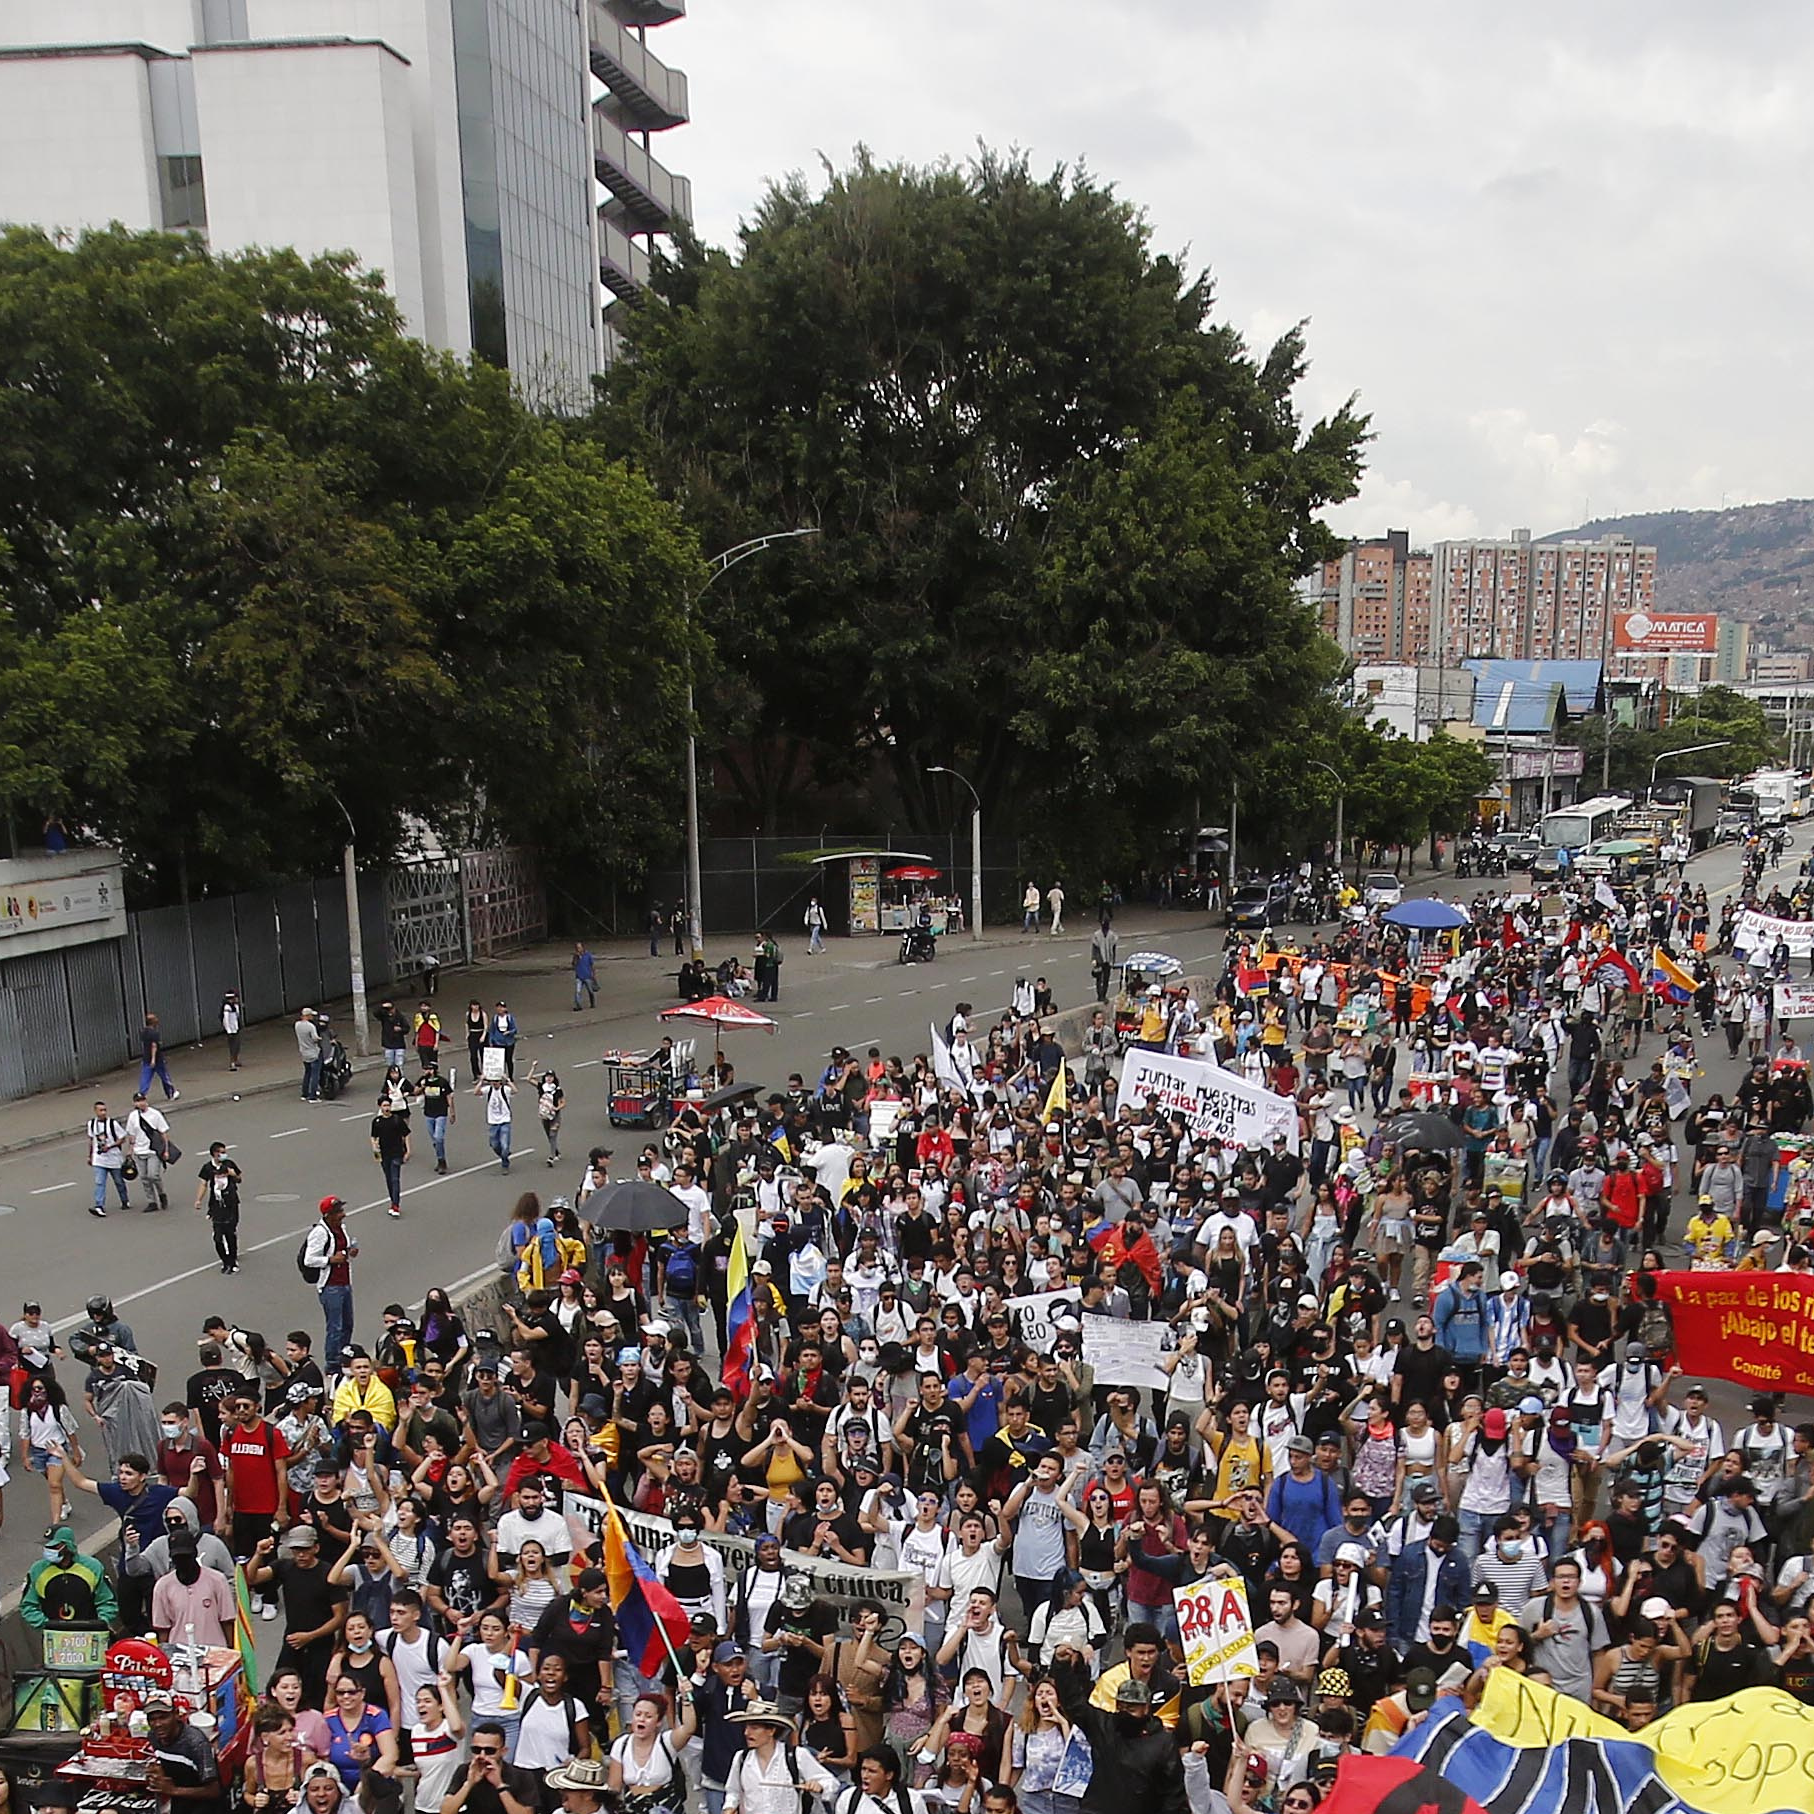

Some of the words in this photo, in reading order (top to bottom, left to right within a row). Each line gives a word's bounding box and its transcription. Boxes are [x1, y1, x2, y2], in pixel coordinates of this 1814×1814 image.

[1137, 1067, 1187, 1093] Juntar
[1196, 1084, 1257, 1117] nuestras
[1202, 1102, 1234, 1125] para
[1706, 1291, 1739, 1309] paz
[1745, 1285, 1769, 1306] de
[1772, 1283, 1801, 1312] los
[1720, 1311, 1777, 1346] ¡Abajo
[1780, 1320, 1798, 1346] el
[1732, 1356, 1782, 1381] Comité
[632, 1520, 671, 1548] una
[1177, 1594, 1215, 1637] 28
[1219, 1590, 1246, 1628] A
